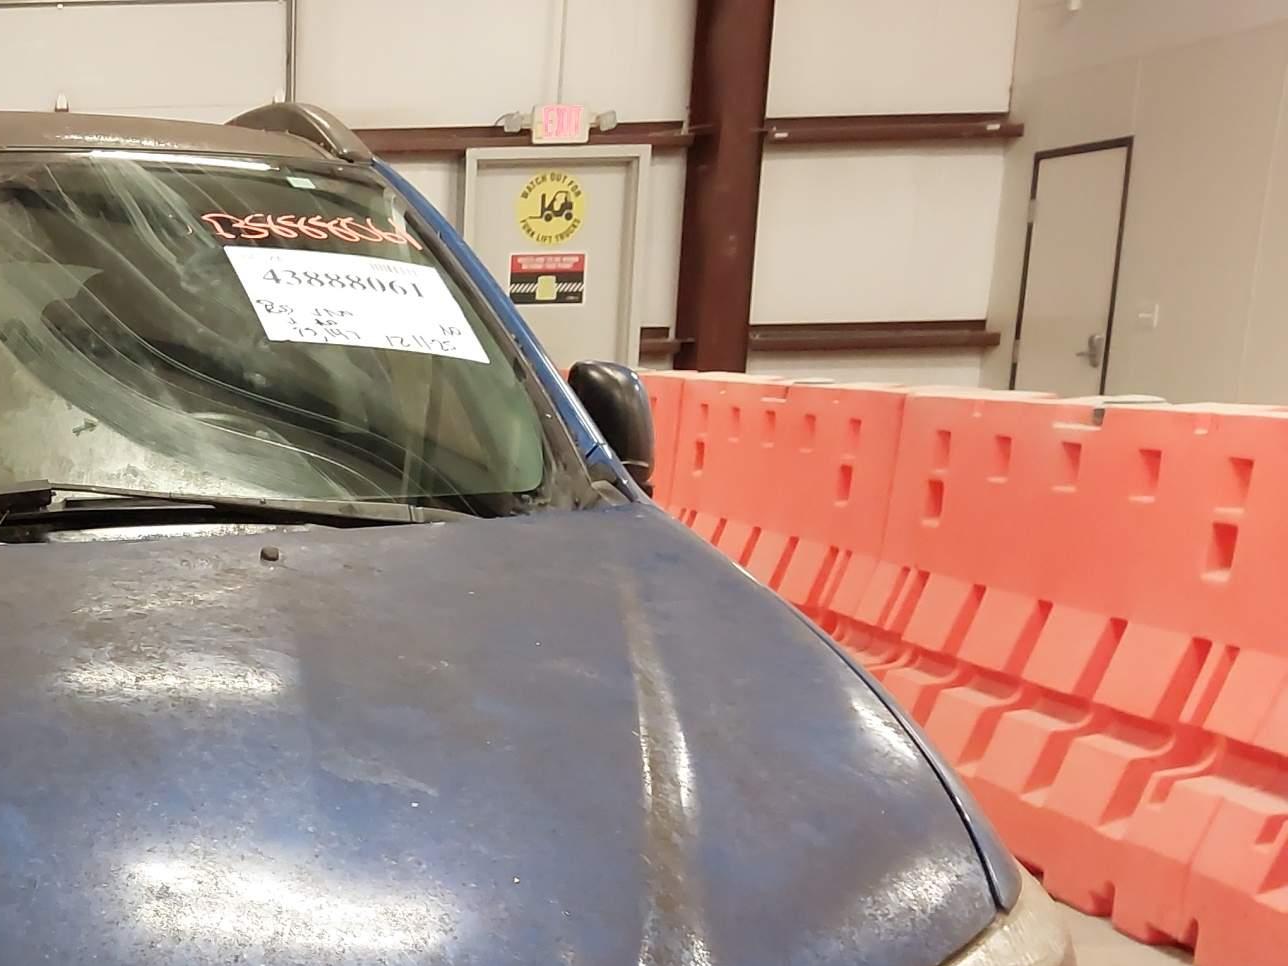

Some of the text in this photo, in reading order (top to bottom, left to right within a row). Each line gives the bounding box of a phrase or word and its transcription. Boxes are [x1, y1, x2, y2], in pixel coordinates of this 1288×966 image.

[543, 104, 584, 137] EXIT
[520, 172, 583, 199] WATCH OUT FOR
[519, 218, 581, 244] FORK LIFT TRUCKS
[262, 268, 424, 298] 43888061
